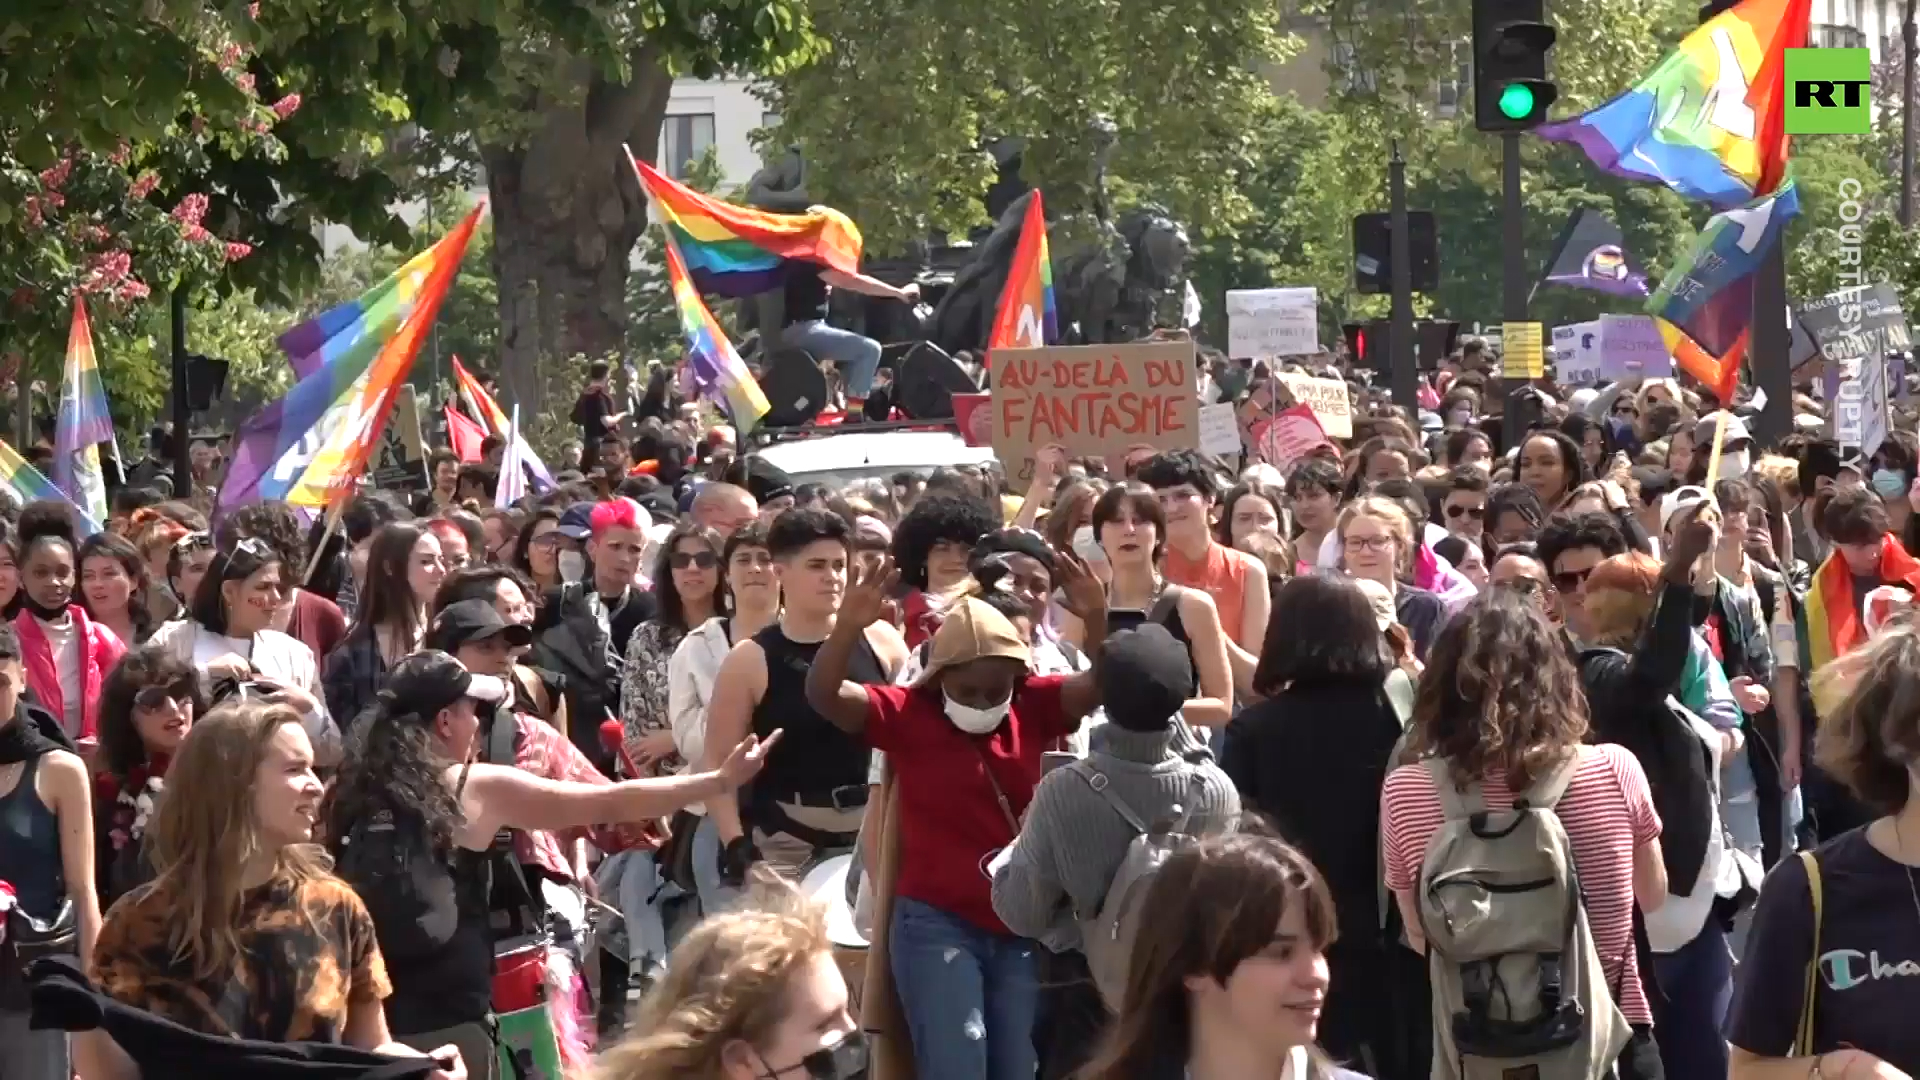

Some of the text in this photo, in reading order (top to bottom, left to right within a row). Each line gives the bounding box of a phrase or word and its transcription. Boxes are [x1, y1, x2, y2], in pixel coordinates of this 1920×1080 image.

[999, 354, 1186, 389] AU-DELÀ DU
[1002, 392, 1187, 442] FANTASME
